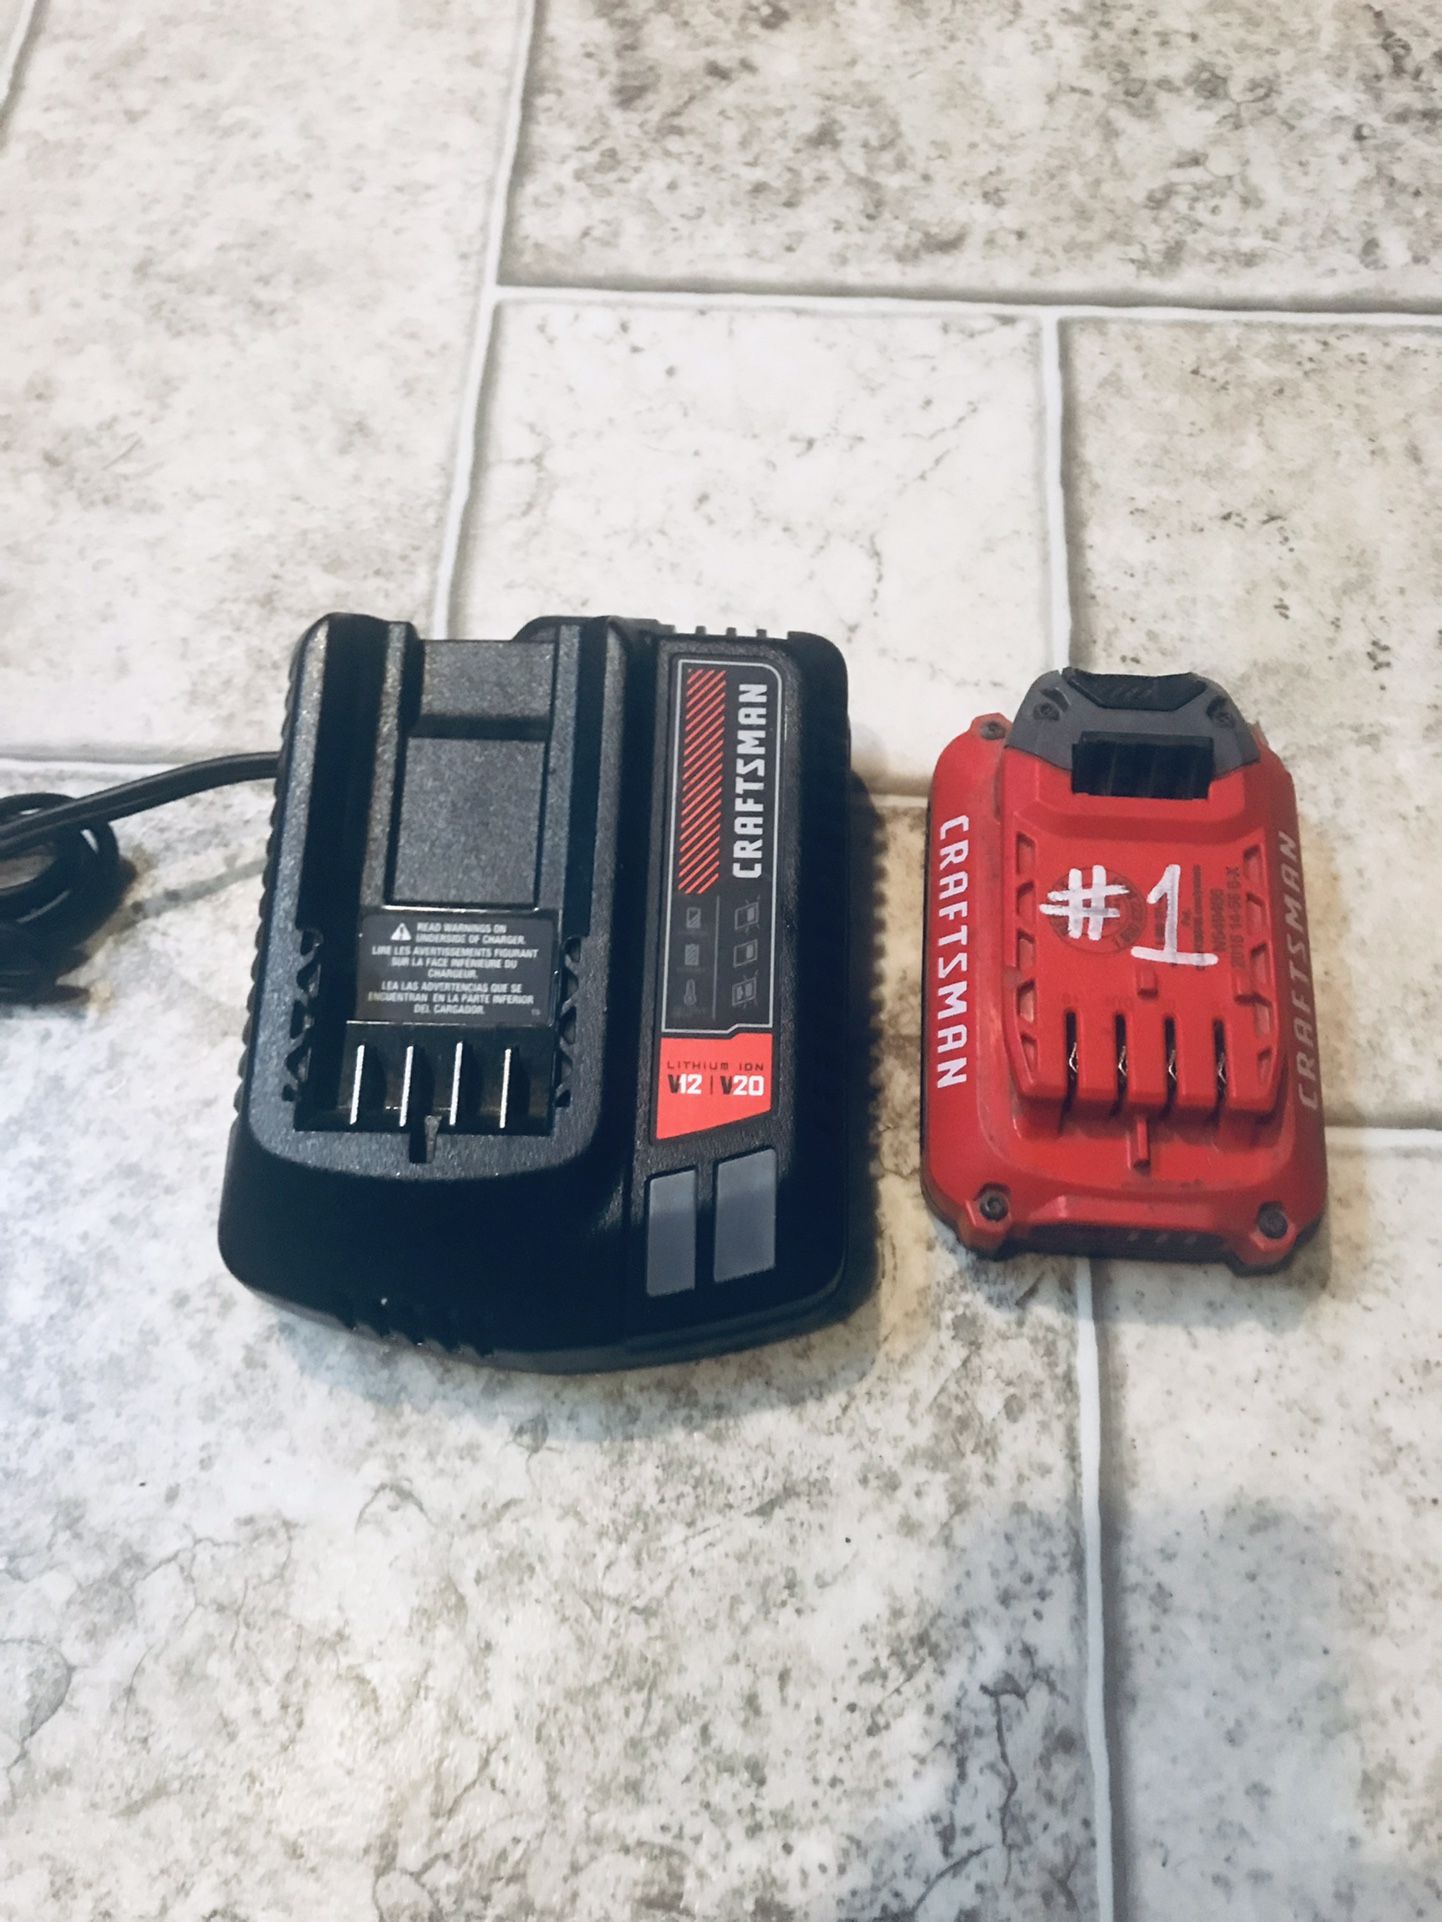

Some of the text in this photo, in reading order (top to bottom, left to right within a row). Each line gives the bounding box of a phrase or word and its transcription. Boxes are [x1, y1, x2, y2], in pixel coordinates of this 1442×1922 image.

[732, 684, 767, 878] CRAFTSMAN
[417, 922, 507, 934] READ WARNINGS ON
[416, 933, 466, 944] UNDERSIDE
[468, 934, 480, 944] OF
[372, 945, 538, 958] LIRE LES AVERTISSEMENTS FIGURANT
[937, 814, 970, 1089] CRAFTSMAN
[391, 956, 410, 967] SUR
[412, 957, 424, 967] LA
[426, 958, 448, 968] FACE
[504, 959, 518, 969] DU
[1278, 831, 1318, 1110] CRAFTSMAN
[381, 981, 522, 994] LEA LAS ADVERTENCIAS QUE SE
[368, 991, 534, 1005] ENCUENTRAN EN LA PARTE INFERIOR
[414, 1004, 430, 1013] DEL
[667, 1060, 764, 1071] LITHIUM ION
[668, 1073, 765, 1097] V12 V20
